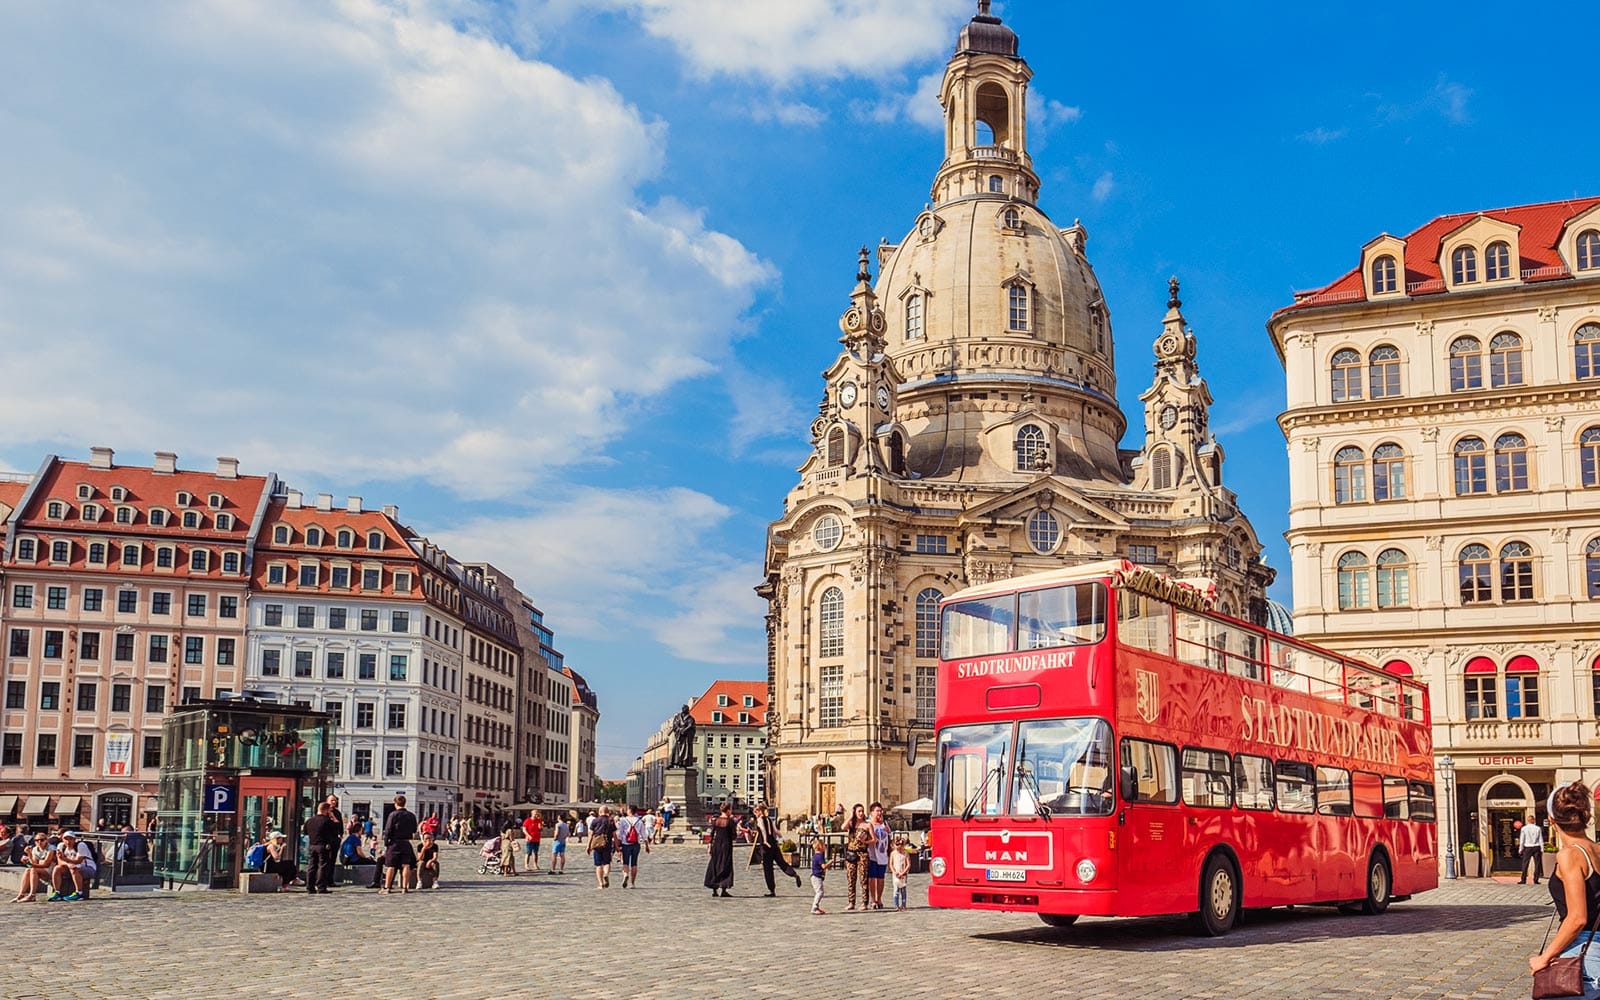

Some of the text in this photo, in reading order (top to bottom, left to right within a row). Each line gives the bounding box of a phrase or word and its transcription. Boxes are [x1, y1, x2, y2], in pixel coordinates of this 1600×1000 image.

[958, 651, 1075, 679] STADTRUNDFAHRT
[1241, 694, 1399, 765] STADTRUNDFAHRT
[1478, 756, 1534, 765] WEMPE
[213, 790, 228, 810] P
[985, 851, 1028, 861] MAN
